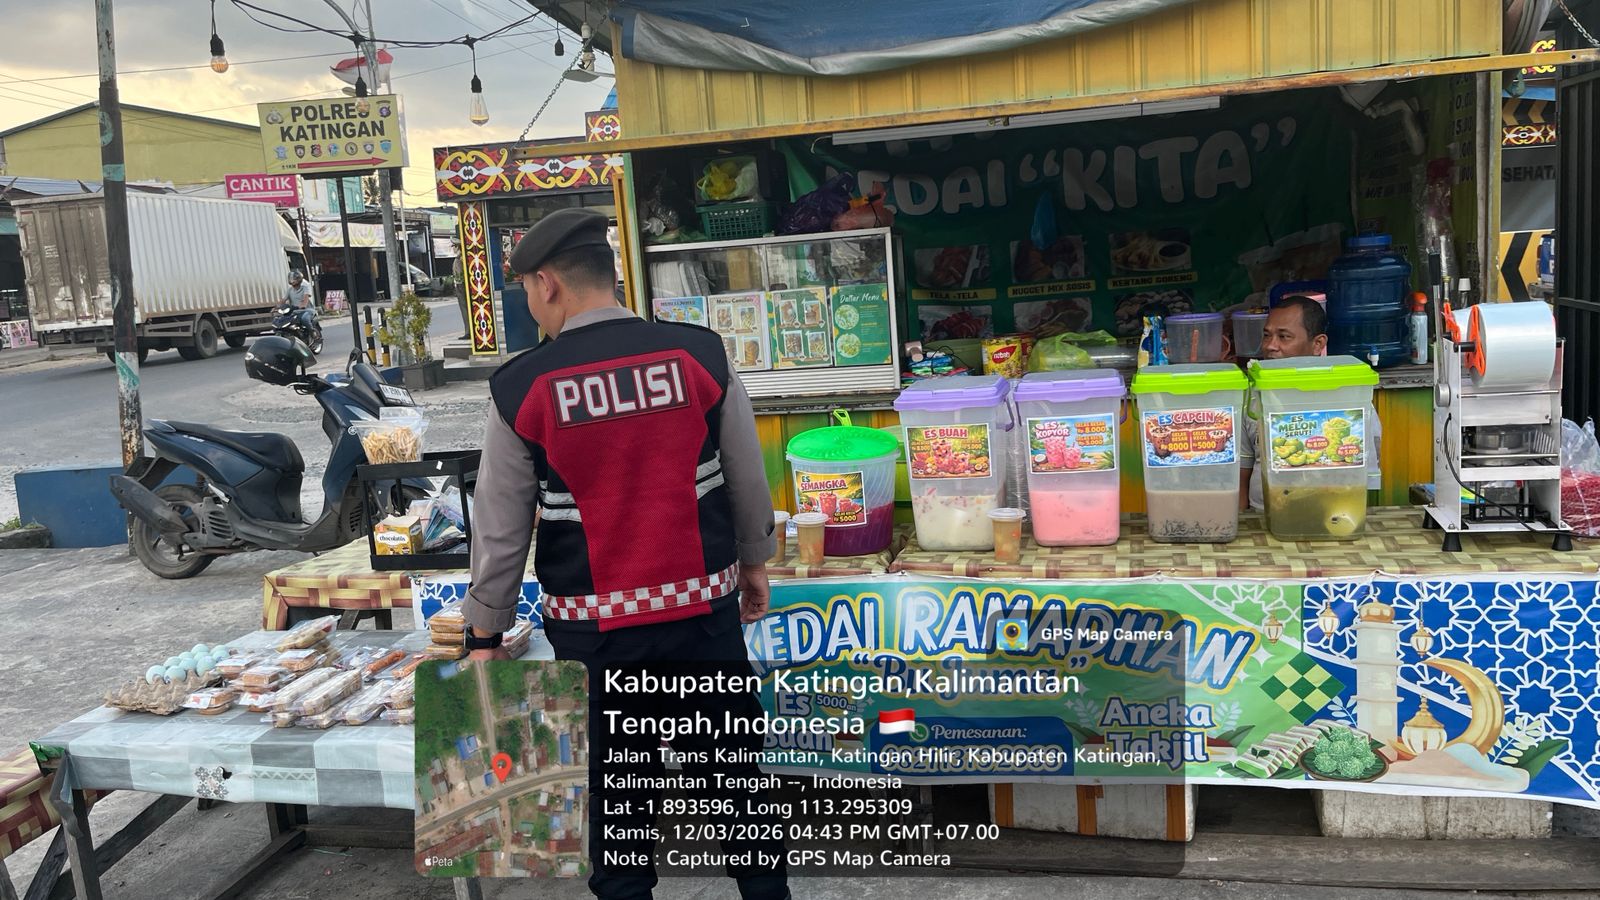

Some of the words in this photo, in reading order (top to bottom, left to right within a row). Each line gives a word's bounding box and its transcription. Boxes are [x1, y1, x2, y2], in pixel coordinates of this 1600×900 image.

[279, 119, 387, 143] KATINGAN
[229, 176, 293, 192] CANTIK
[826, 158, 1007, 217] EDAI
[929, 291, 951, 300] TELA
[1012, 286, 1046, 296] NUGGET
[1047, 284, 1064, 294] MIX
[1066, 282, 1092, 292] SOSIS
[861, 292, 880, 302] Menu
[555, 362, 685, 422] POLISI
[1157, 414, 1172, 425] ES
[1172, 412, 1216, 424] CAPCIN
[1043, 421, 1057, 430] ES
[1278, 421, 1318, 433] MELON
[924, 429, 937, 439] ES
[938, 427, 969, 439] BUAH
[1035, 428, 1070, 439] KOPYOR
[1284, 430, 1312, 439] SERUT!
[1167, 442, 1189, 451] 8000
[1197, 441, 1217, 450] 5000
[800, 478, 848, 491] SEMANGKA
[801, 475, 811, 483] ES
[902, 592, 1256, 690] RAMADHAN
[778, 688, 812, 717] Es
[1102, 700, 1215, 729] Aneka
[930, 724, 1028, 741] Pemesanan:
[1108, 732, 1210, 769] Takjil
